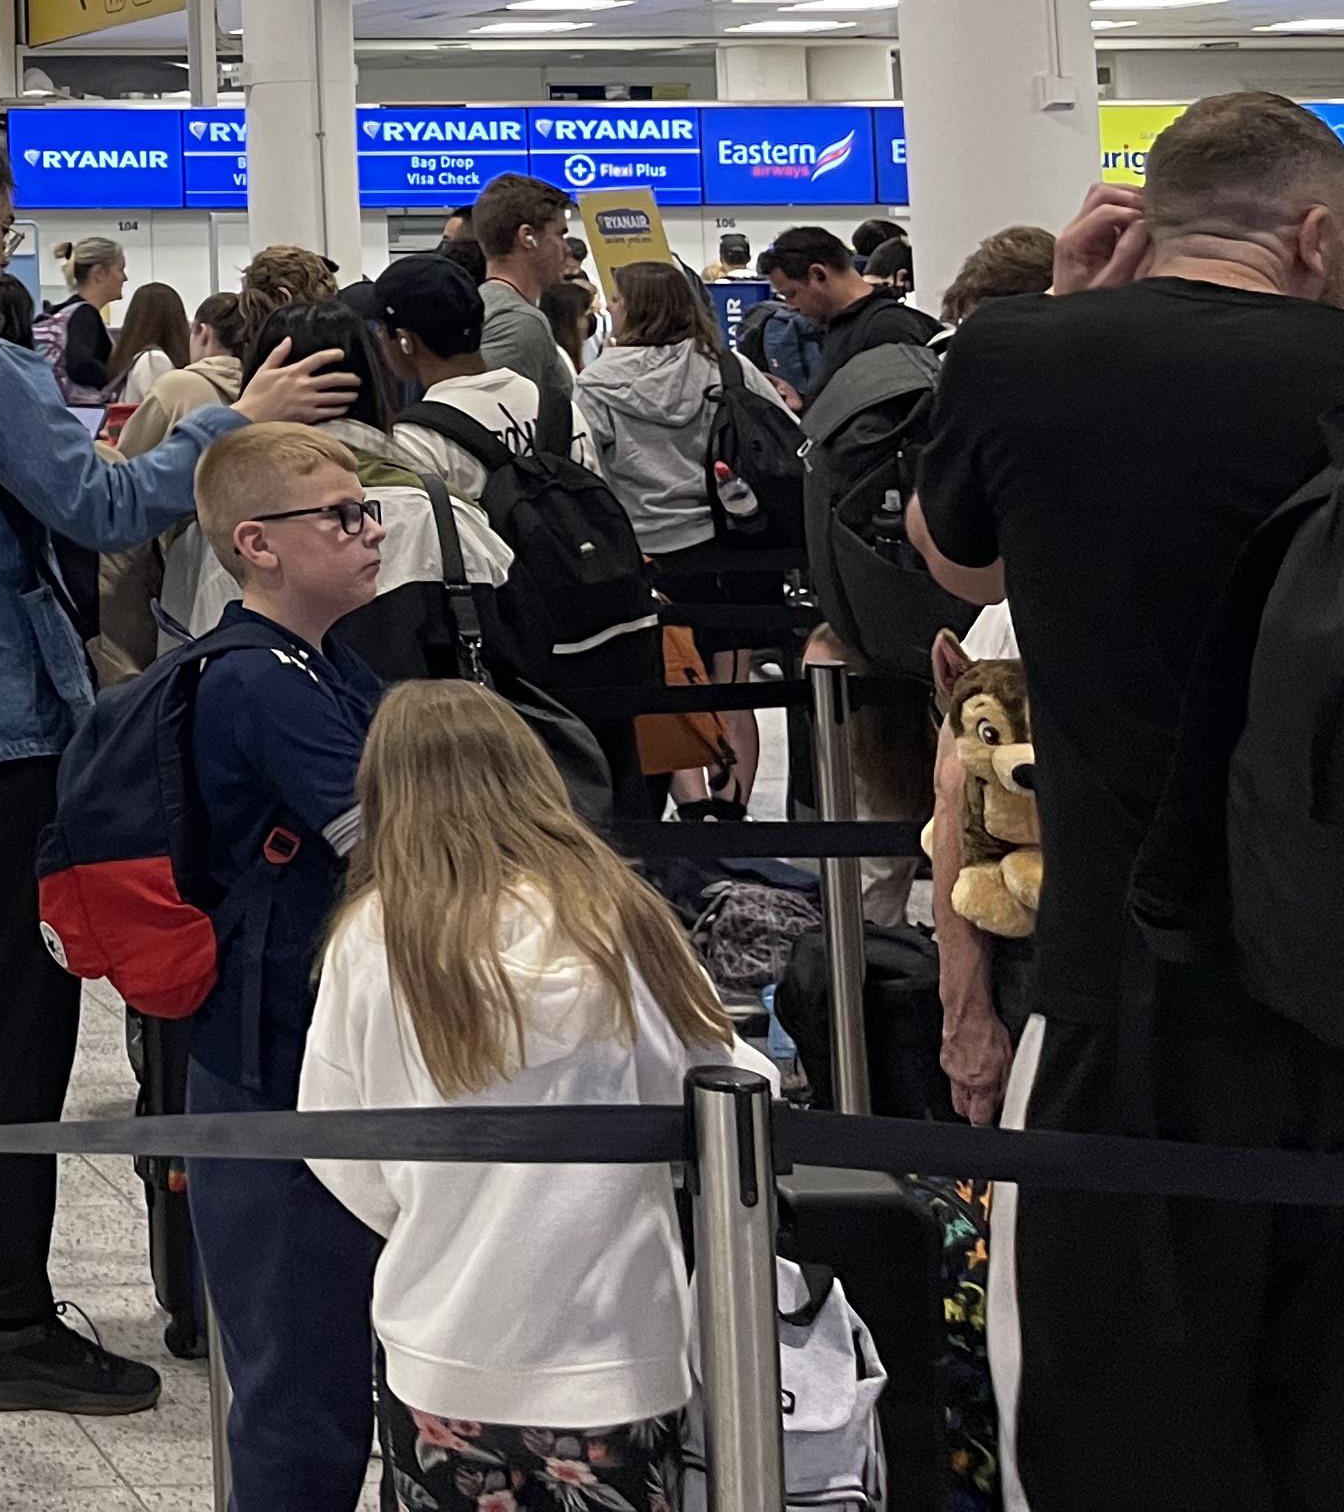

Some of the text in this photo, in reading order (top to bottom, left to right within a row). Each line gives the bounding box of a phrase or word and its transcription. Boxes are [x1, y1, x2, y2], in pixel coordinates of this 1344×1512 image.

[383, 121, 522, 141] RYANAIR
[556, 119, 694, 140] RYANAIR
[43, 150, 169, 169] RYANAIR
[718, 140, 816, 165] Eastern
[411, 156, 474, 172] Bag Drop
[600, 164, 667, 178] Flexi Plus
[407, 173, 480, 186] Visa Check
[752, 166, 810, 179] airways
[603, 215, 650, 229] RYANAIR
[716, 218, 736, 228] 106
